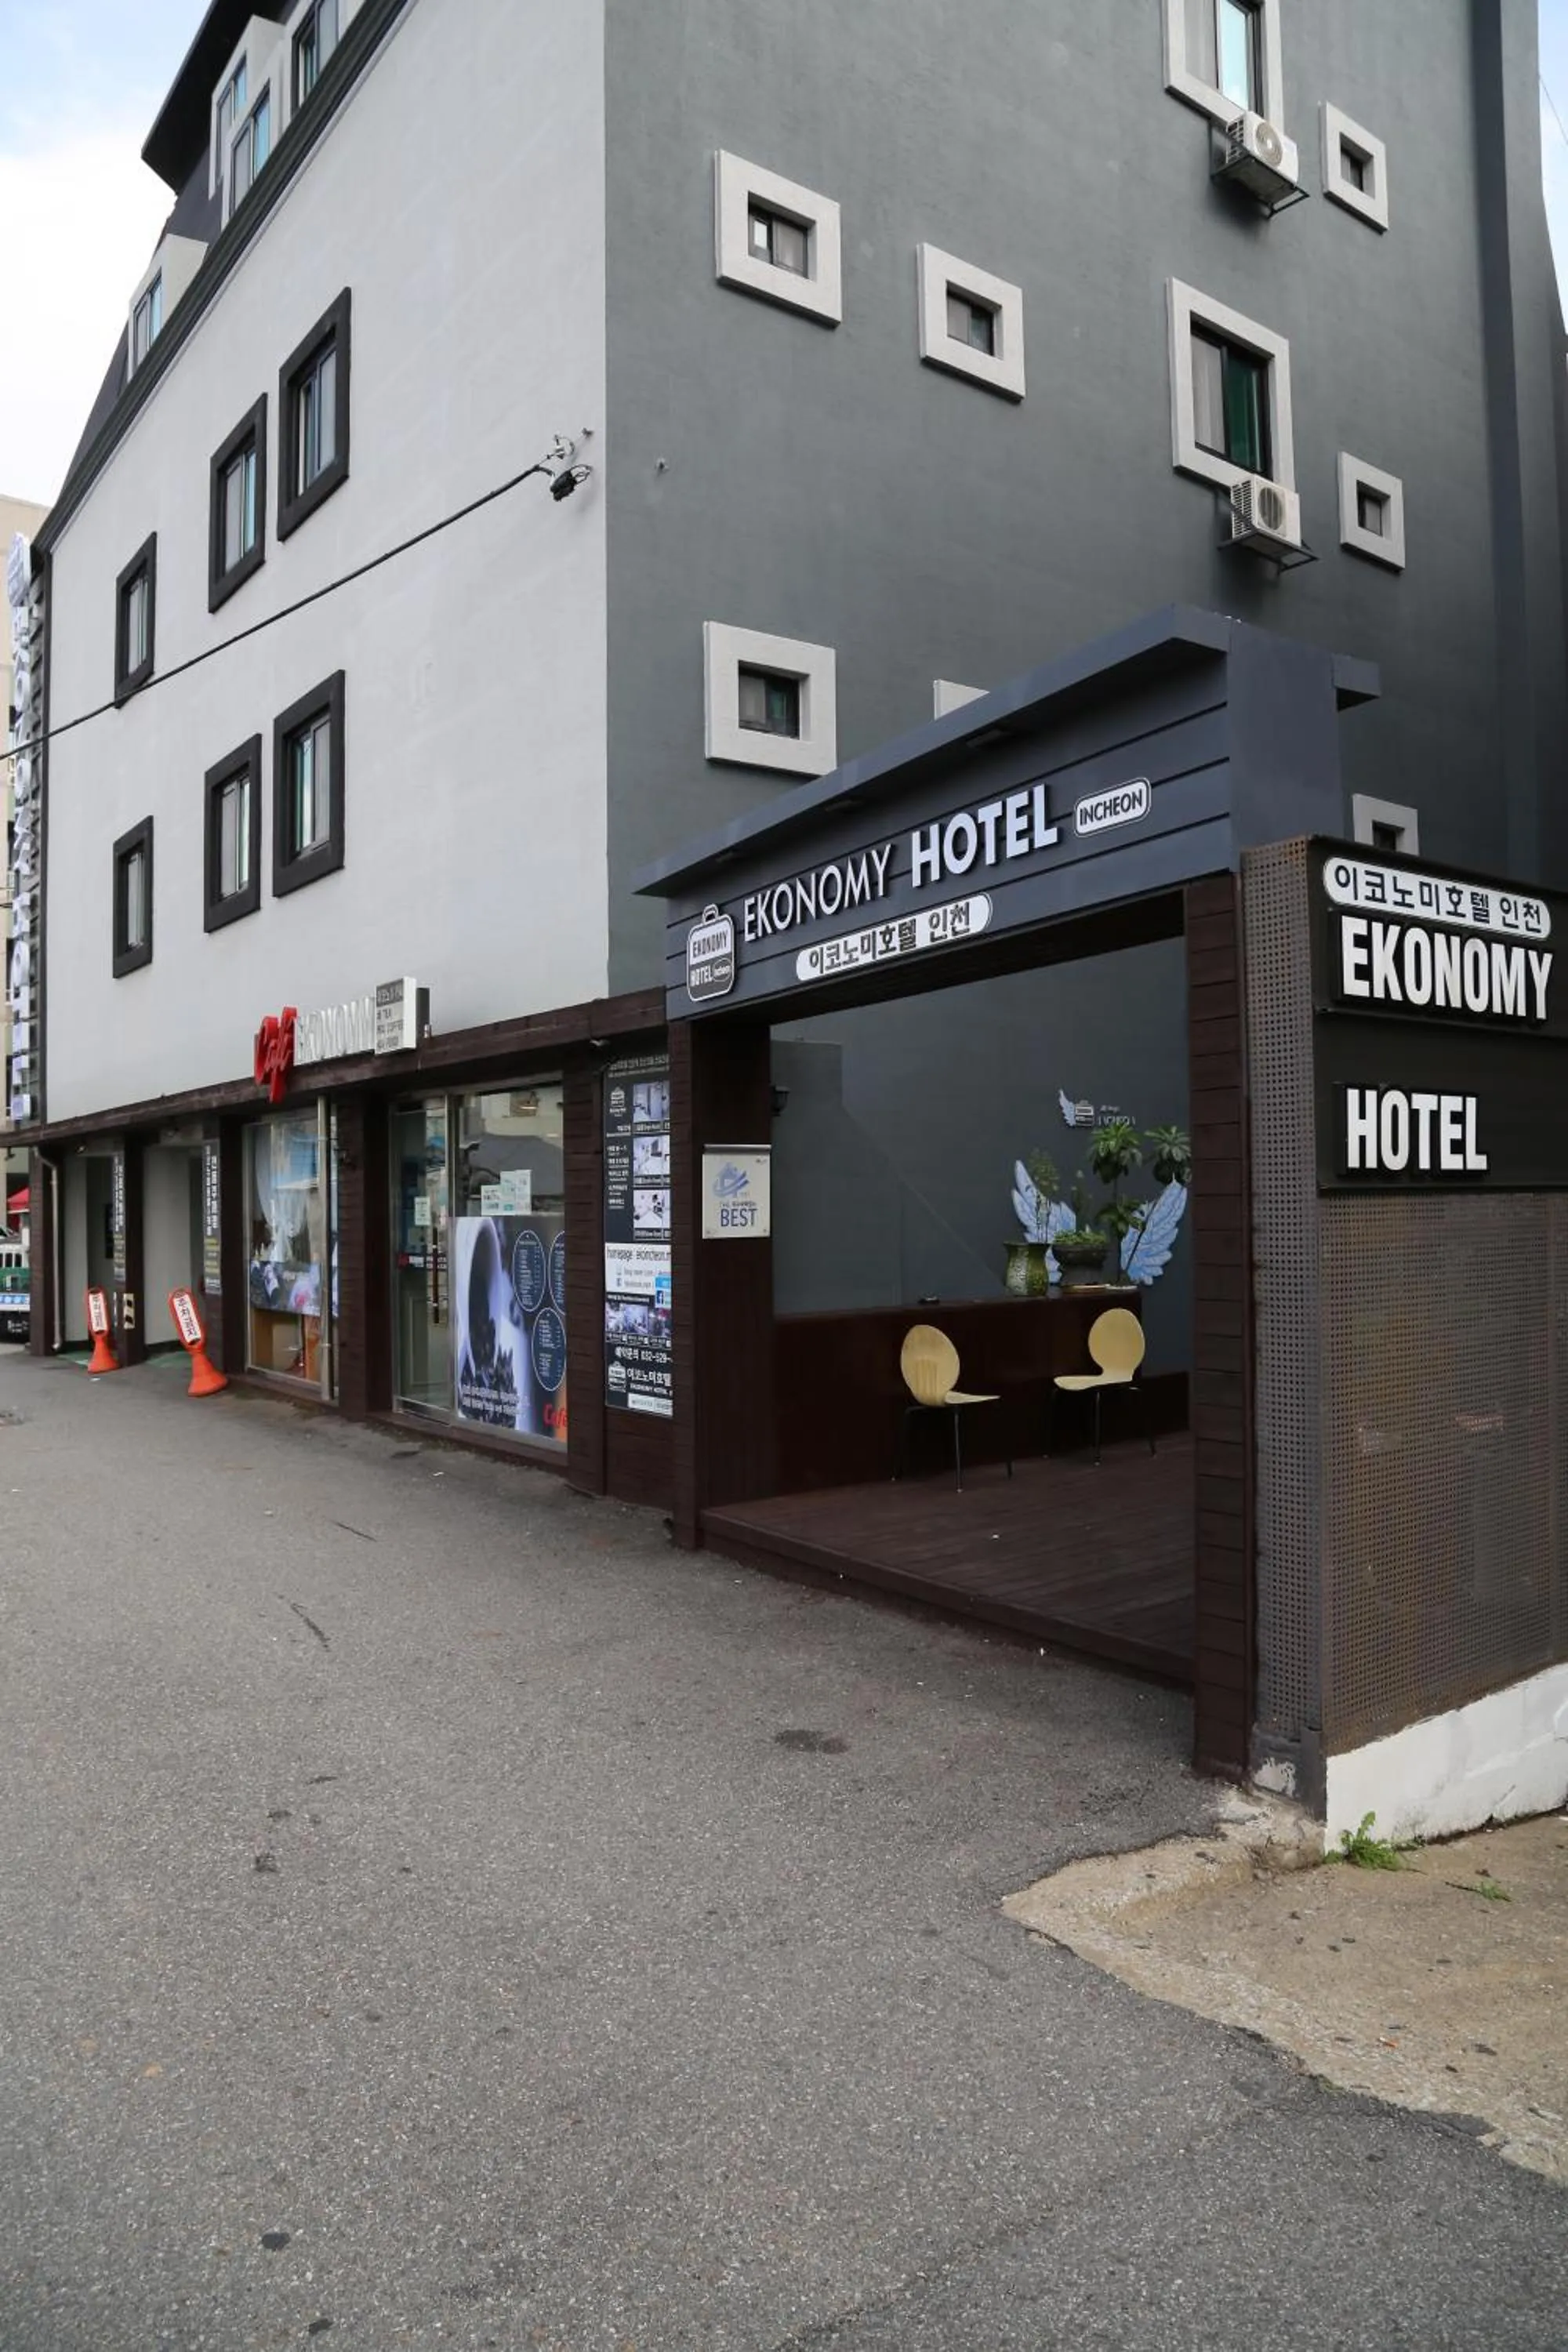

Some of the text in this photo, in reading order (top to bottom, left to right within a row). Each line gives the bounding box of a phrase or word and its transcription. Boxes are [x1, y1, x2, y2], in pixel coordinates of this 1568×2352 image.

[1079, 788, 1145, 826] INCHEON
[743, 783, 1058, 942] EKONOMY HOTEL
[1334, 865, 1542, 935] 이코노미호텔 인천
[809, 902, 971, 977] 이코노미호텔 인천
[1341, 915, 1553, 1019] EKONOMY
[690, 964, 714, 988] HOTEL
[1345, 1087, 1488, 1171] HOTEL
[720, 1208, 758, 1227] BEST
